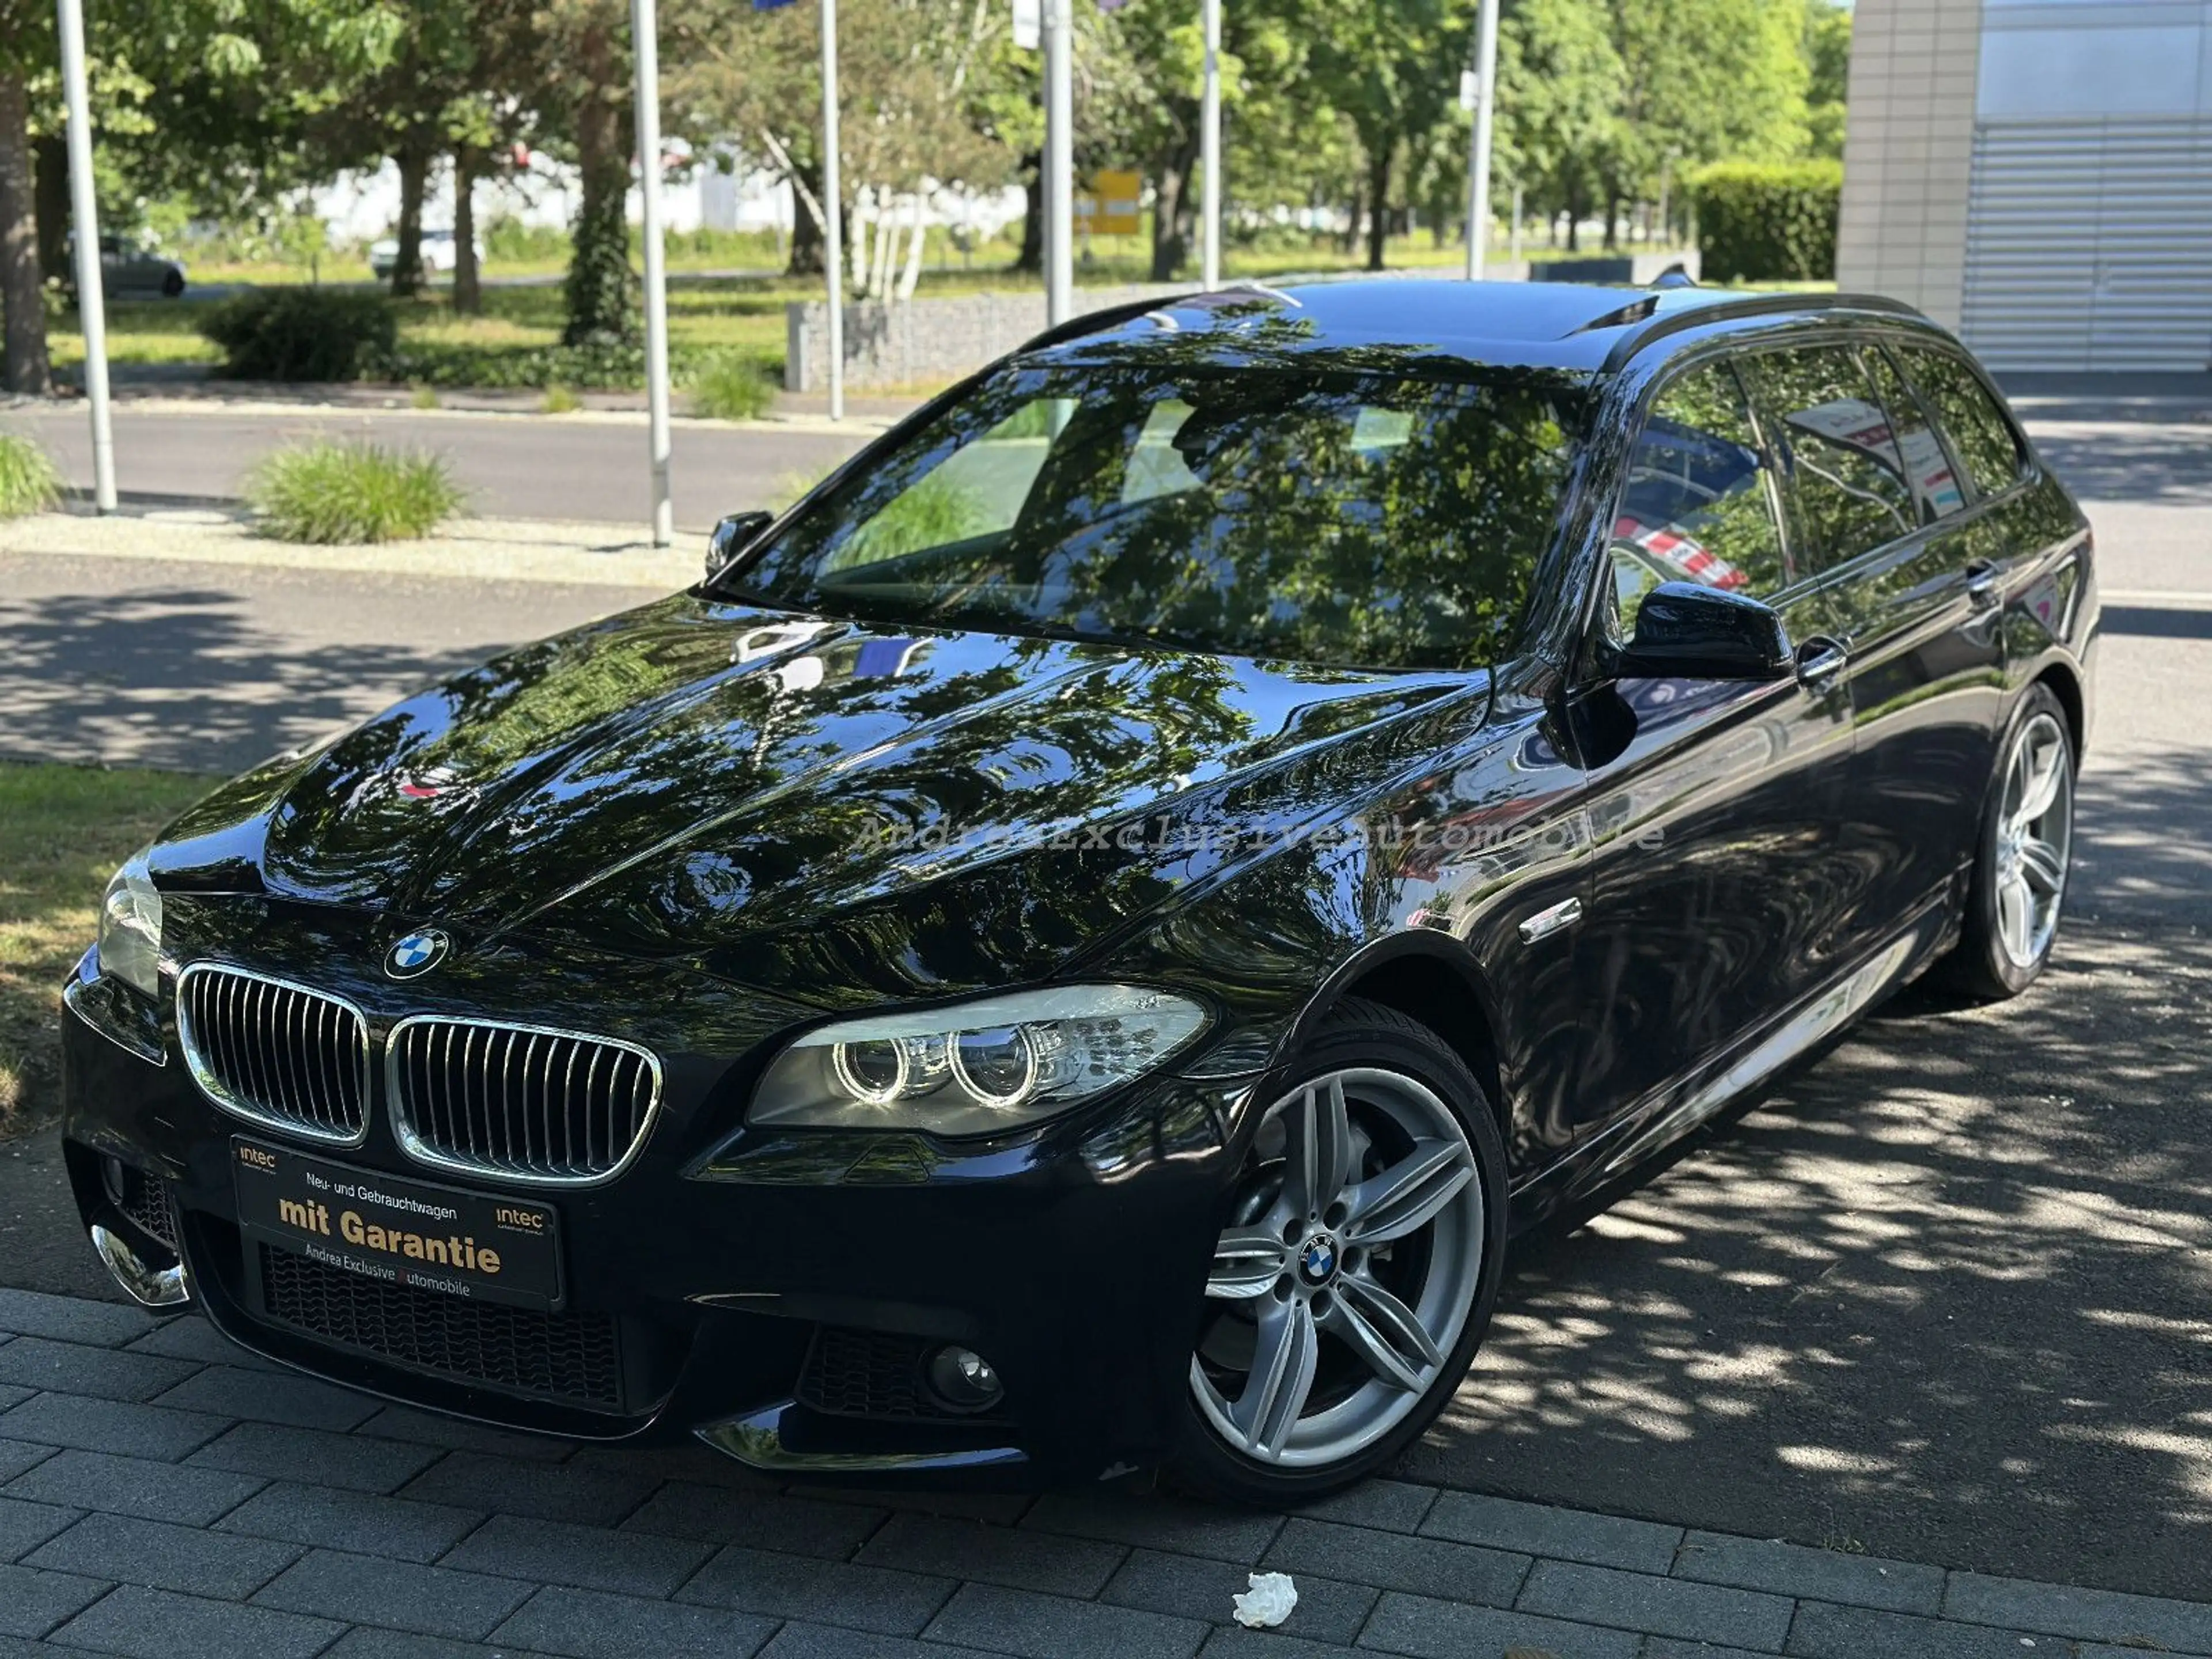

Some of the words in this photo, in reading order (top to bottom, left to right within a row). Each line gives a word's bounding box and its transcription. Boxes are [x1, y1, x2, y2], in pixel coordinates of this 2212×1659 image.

[306, 1172, 331, 1191] Neu-
[334, 1183, 355, 1198] und
[358, 1186, 457, 1221] Gebrauchtwagen
[279, 1198, 331, 1236] mit
[339, 1210, 501, 1274] Garantie
[305, 1243, 341, 1266] Andrea
[344, 1255, 395, 1281] Exclusive
